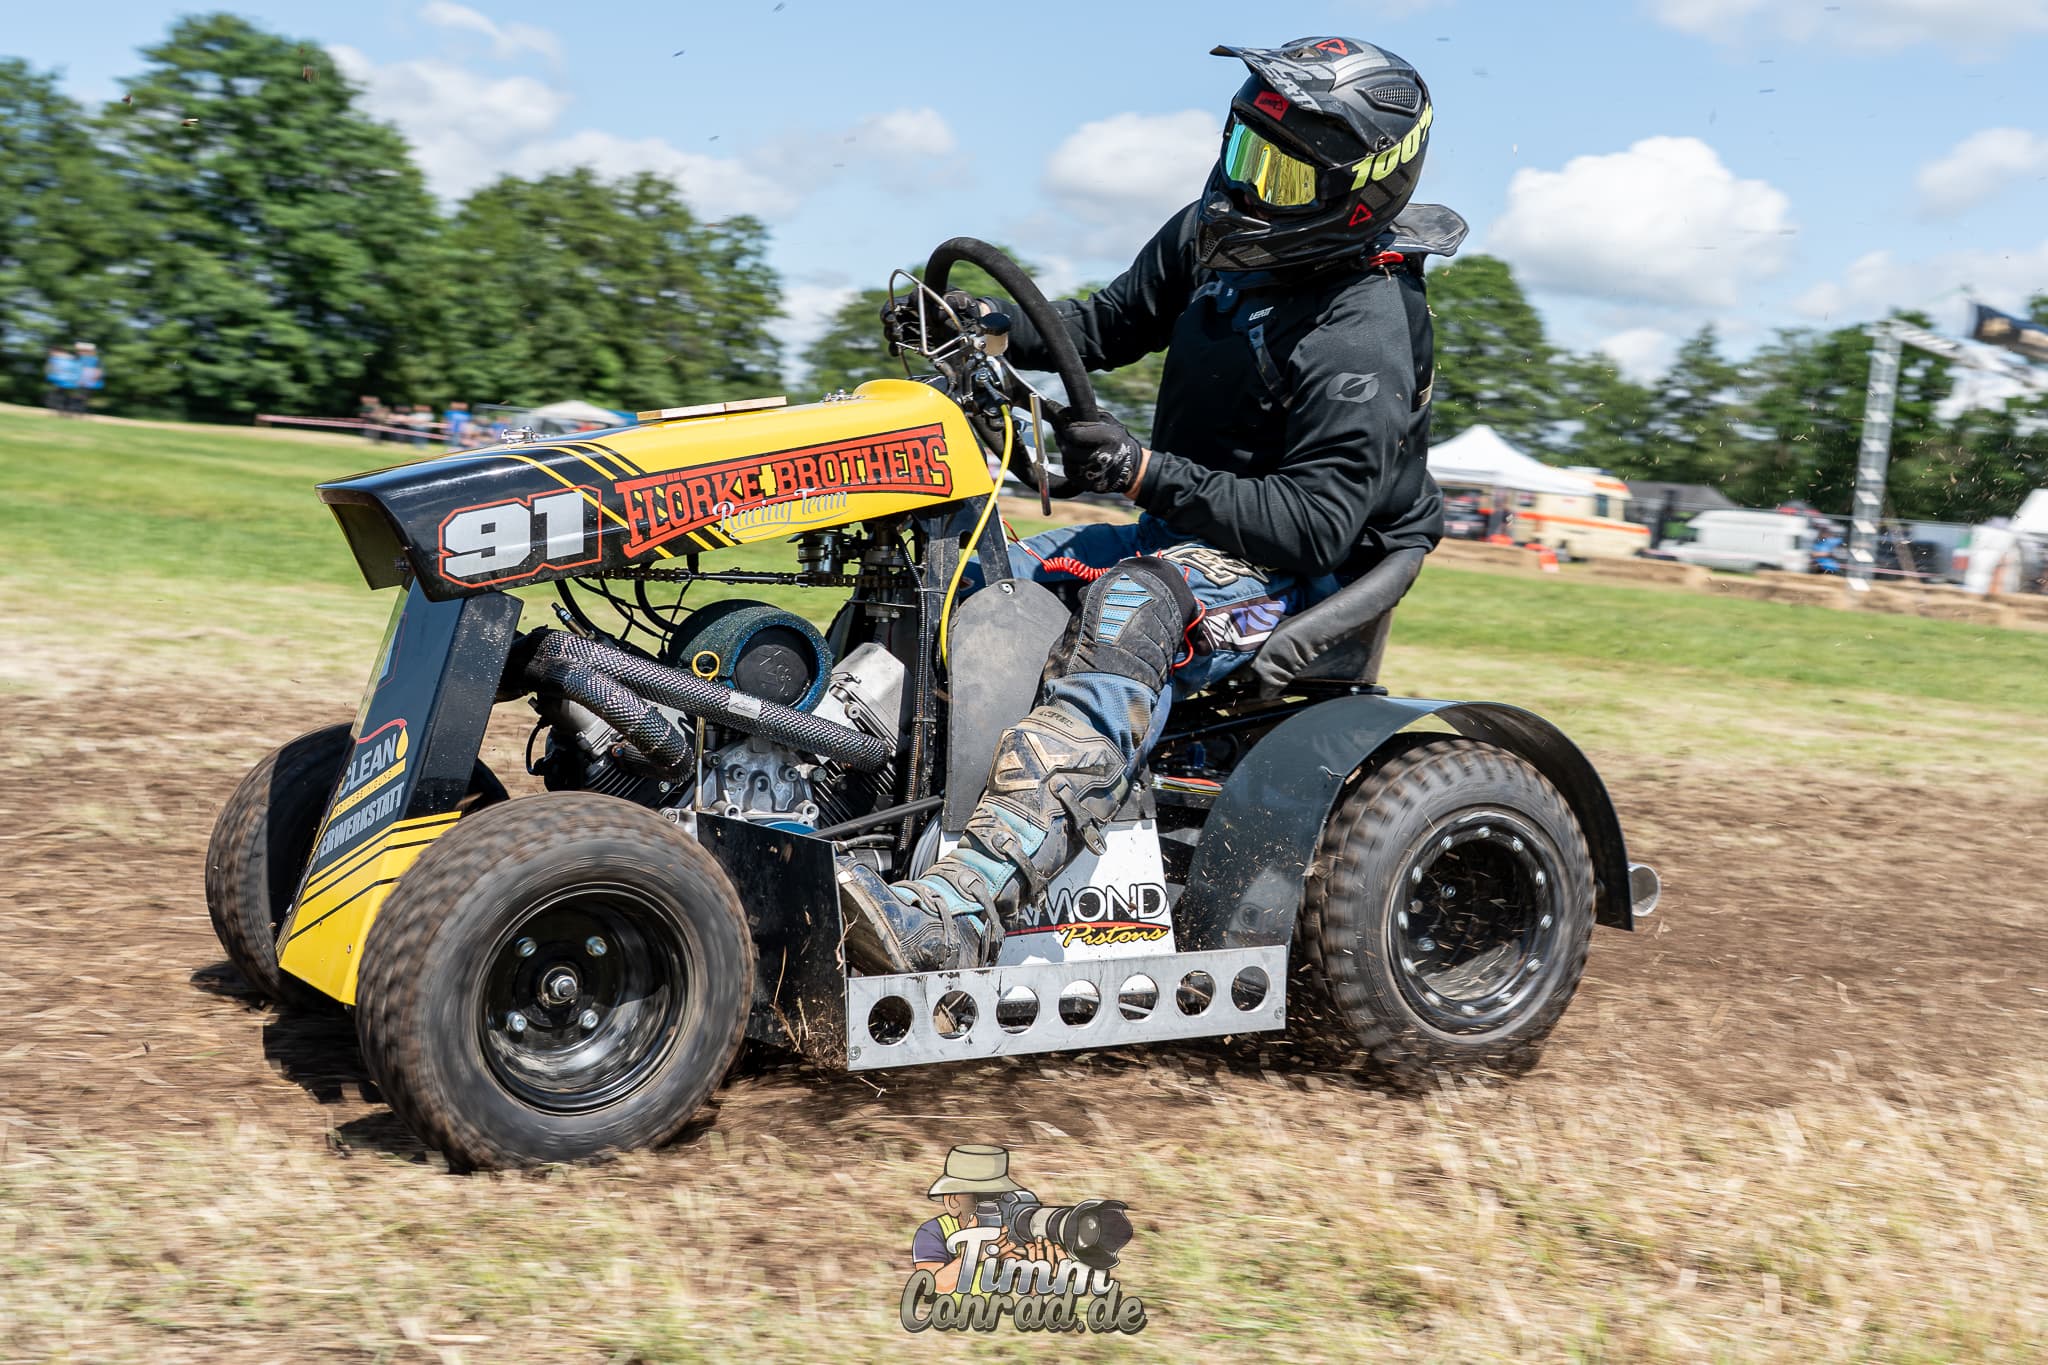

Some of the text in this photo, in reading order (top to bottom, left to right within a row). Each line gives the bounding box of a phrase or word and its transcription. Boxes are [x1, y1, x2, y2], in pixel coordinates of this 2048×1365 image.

[772, 436, 953, 497] BROTHERS
[445, 491, 584, 578] 91
[712, 487, 847, 533] Racing Team
[1060, 923, 1169, 948] Pistons
